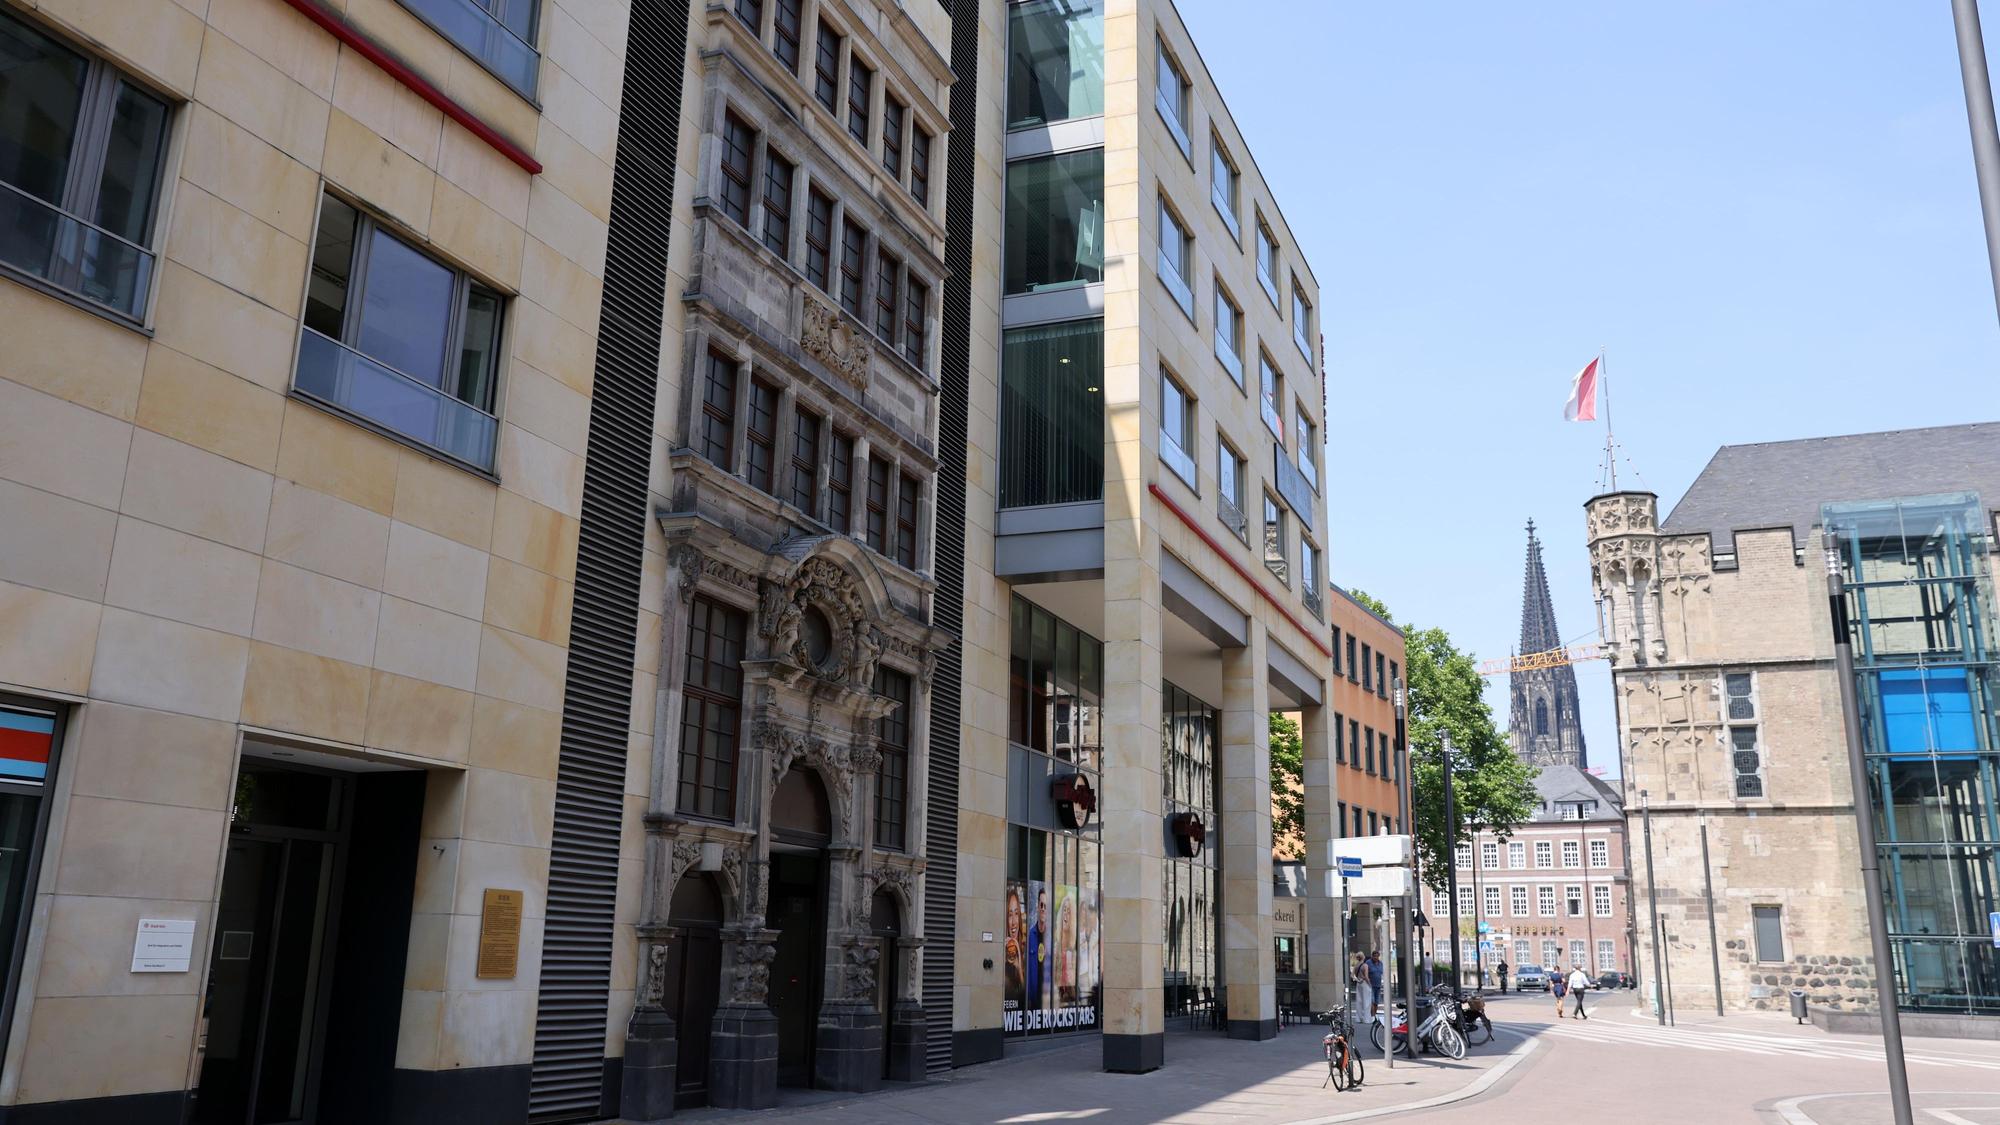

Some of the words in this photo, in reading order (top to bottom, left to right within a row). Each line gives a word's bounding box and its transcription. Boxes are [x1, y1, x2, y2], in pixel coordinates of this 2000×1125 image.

[1275, 908, 1295, 923] ckerei
[1003, 1000, 1019, 1009] FEIERN
[1004, 1010, 1023, 1032] WIE
[1026, 1009, 1042, 1030] DIE
[1042, 1006, 1095, 1029] ROCKSTARS
